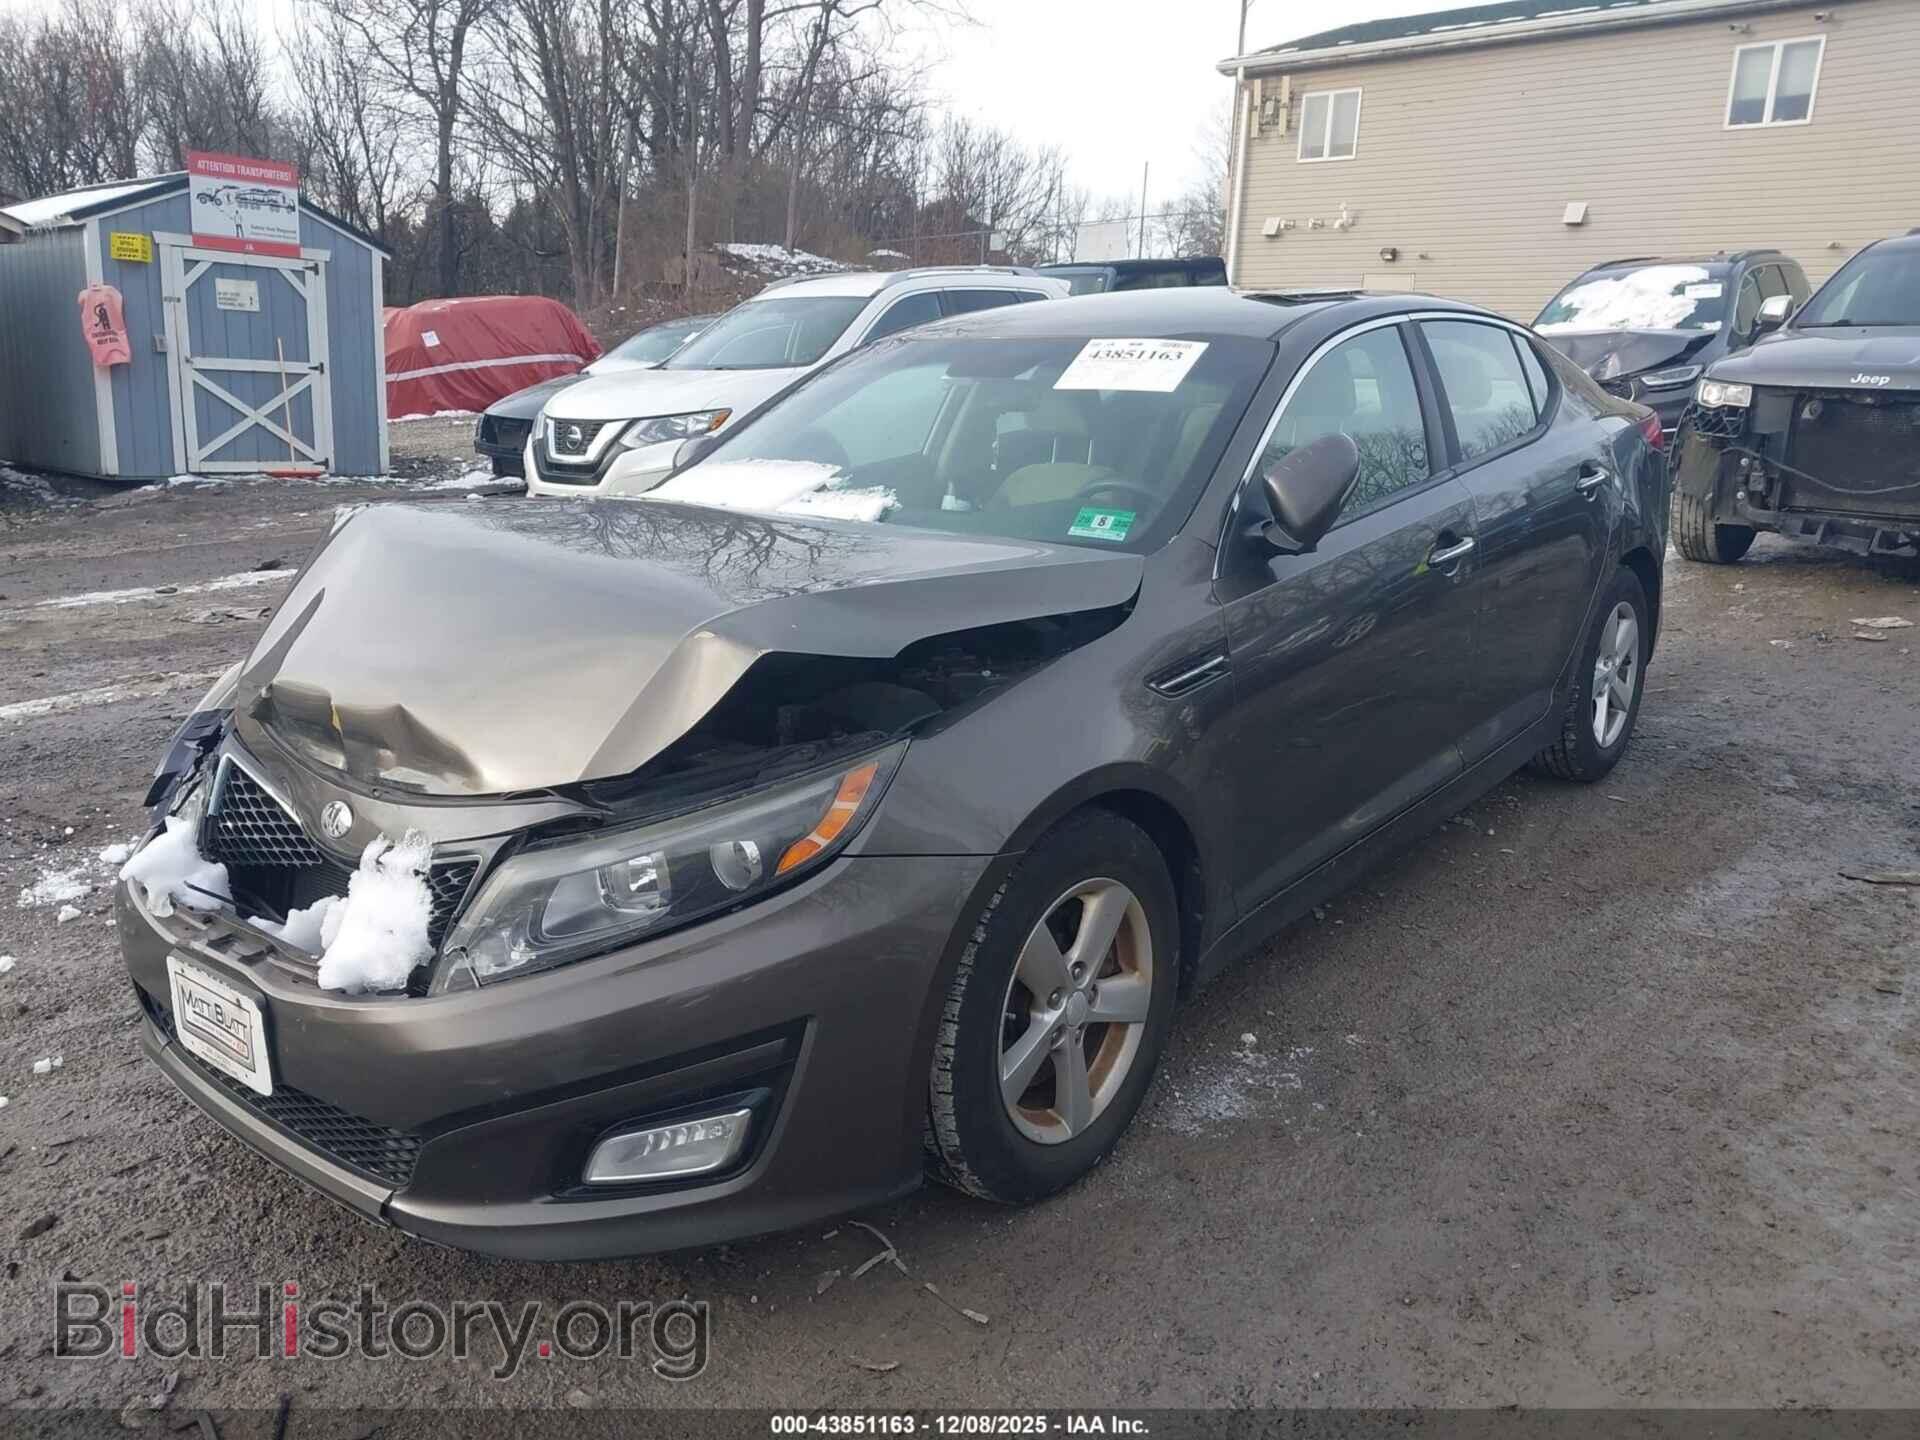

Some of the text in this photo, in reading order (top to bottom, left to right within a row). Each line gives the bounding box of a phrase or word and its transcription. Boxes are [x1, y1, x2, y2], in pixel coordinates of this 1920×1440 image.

[197, 160, 293, 181] ATTENTION TRANSPORTERS!
[1088, 349, 1184, 361] 43851163
[1850, 373, 1890, 386] Jeep
[1097, 516, 1108, 527] 8
